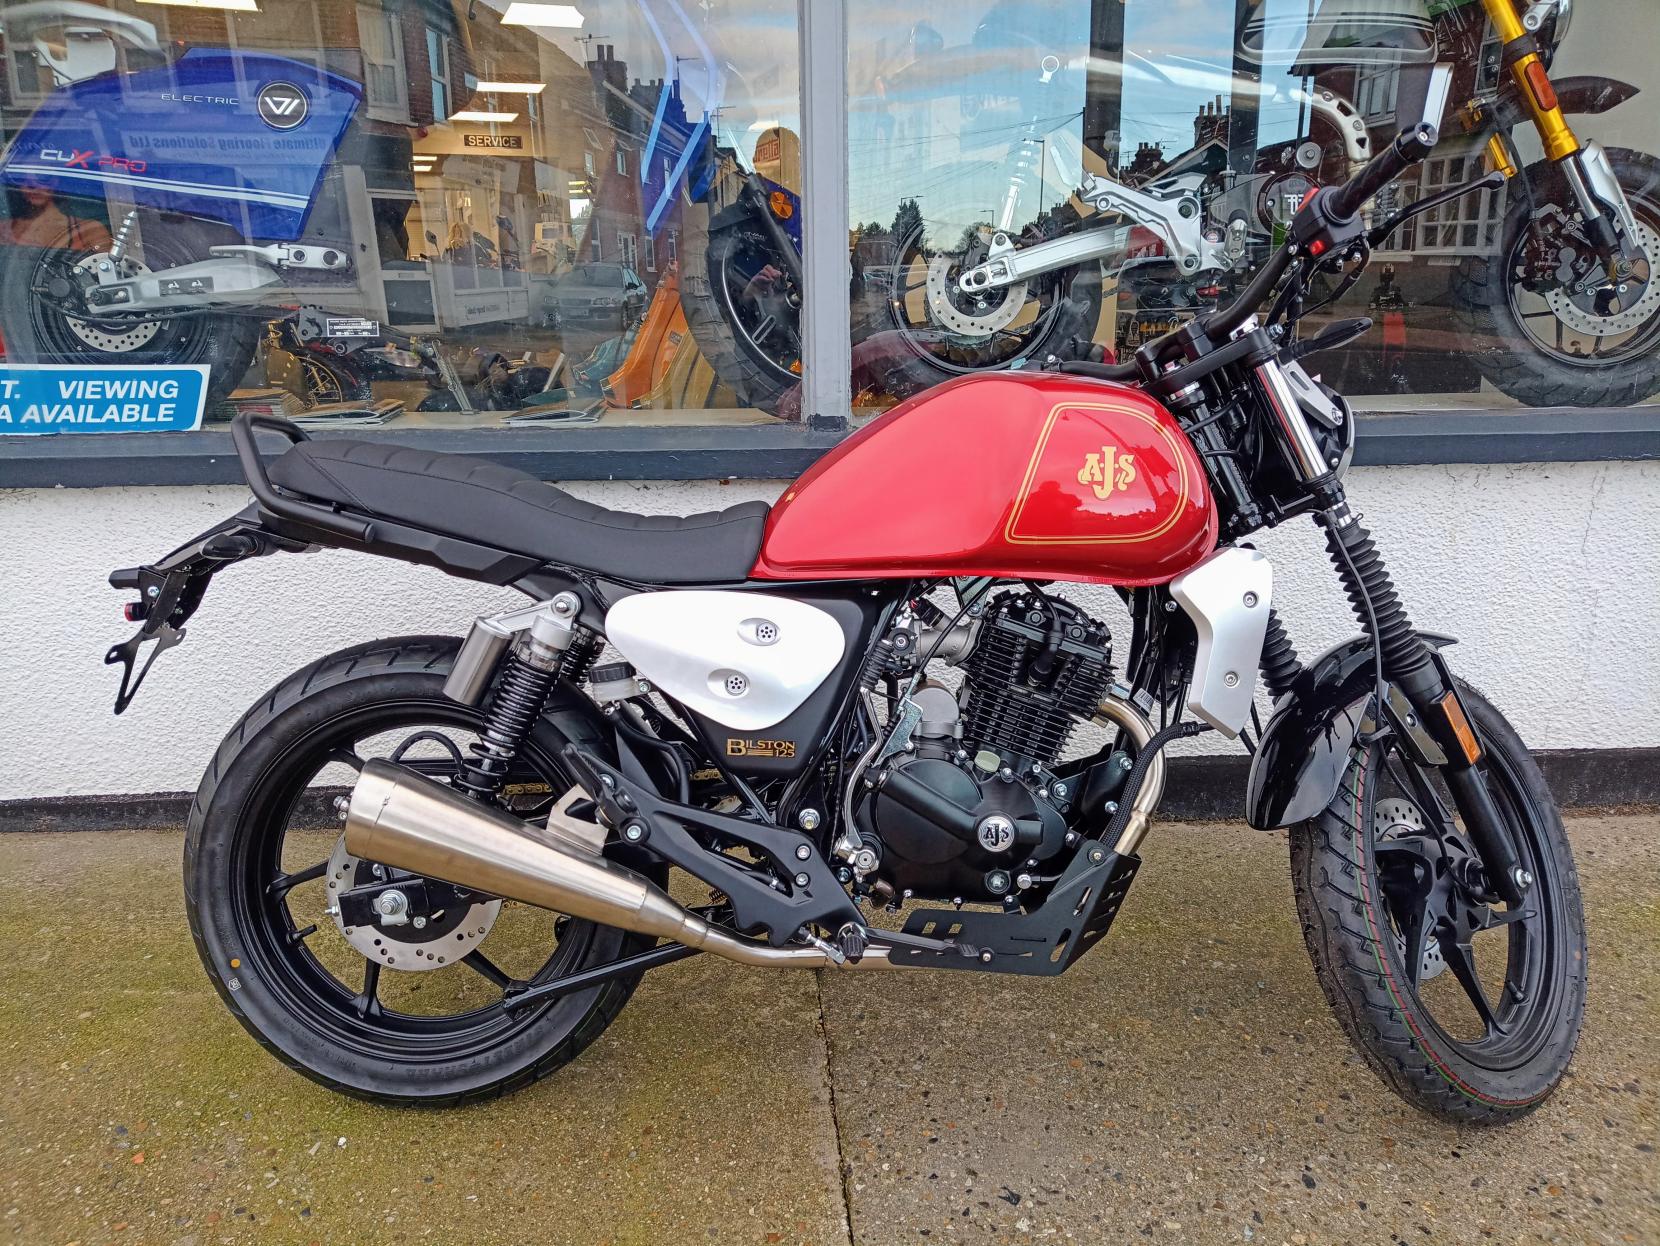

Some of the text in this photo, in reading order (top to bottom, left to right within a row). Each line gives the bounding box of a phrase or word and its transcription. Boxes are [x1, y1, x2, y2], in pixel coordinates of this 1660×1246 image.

[161, 93, 239, 105] ELECTRIC
[468, 135, 517, 147] SERVICE
[98, 156, 147, 173] PRO
[58, 379, 179, 399] VIEWING
[20, 403, 176, 424] AVAILABLE
[727, 738, 795, 756] BILSTON
[775, 749, 795, 758] 125
